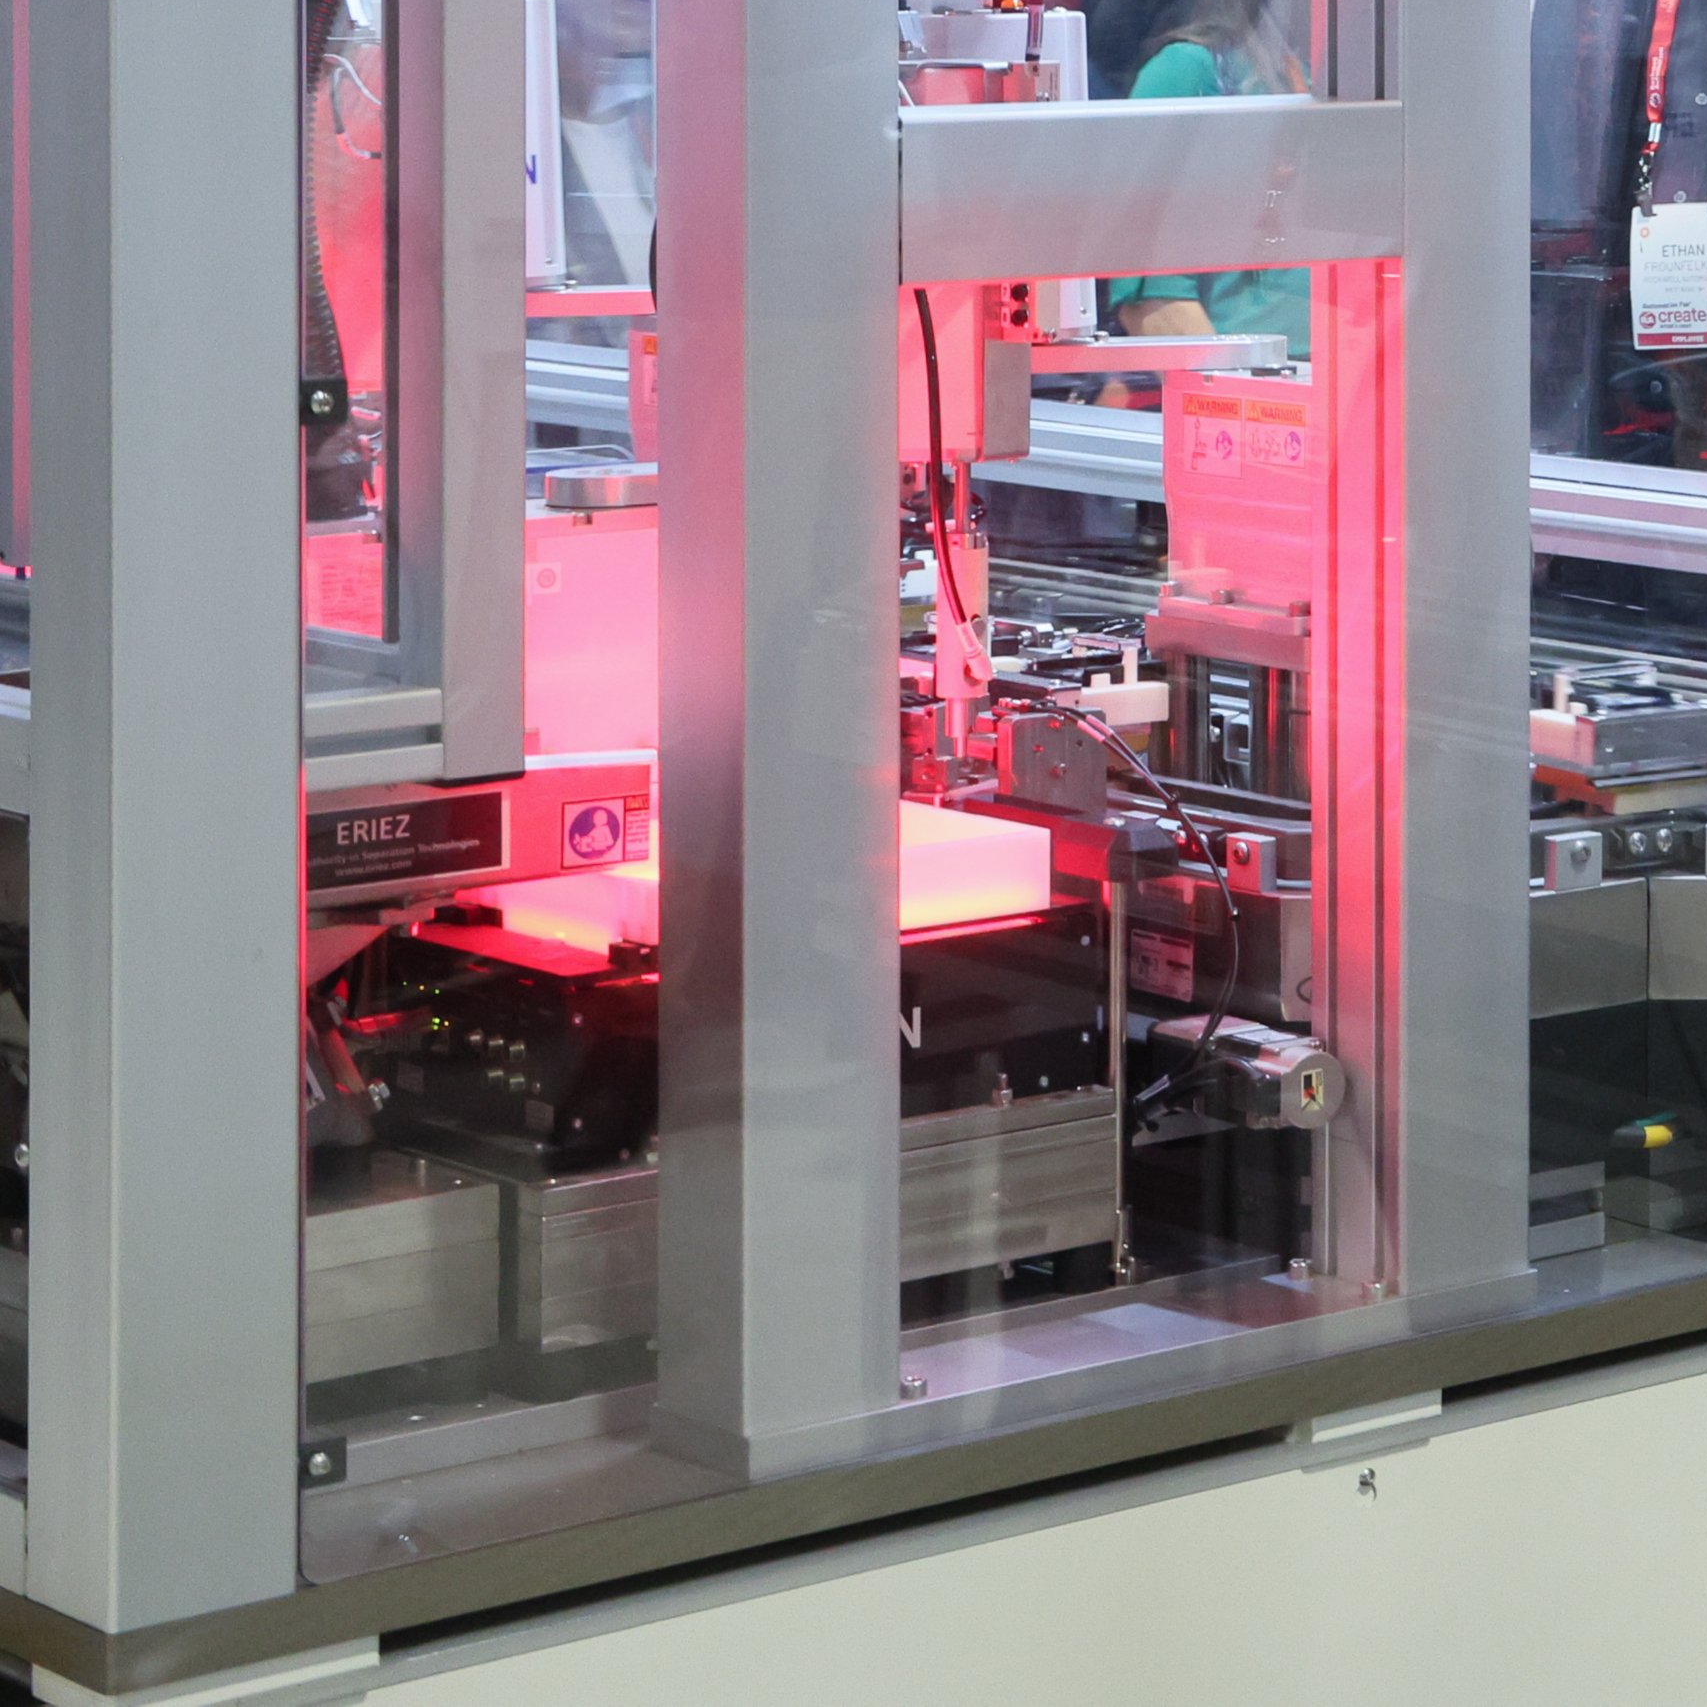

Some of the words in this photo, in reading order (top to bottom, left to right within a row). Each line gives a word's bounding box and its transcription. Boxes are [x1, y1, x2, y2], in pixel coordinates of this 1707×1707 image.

[1662, 244, 1706, 258] ETHAN
[1658, 308, 1707, 323] create
[1197, 400, 1239, 415] WARNING
[1260, 406, 1303, 422] WARNING
[336, 814, 411, 845] ERIEZ
[307, 851, 346, 867] uthority
